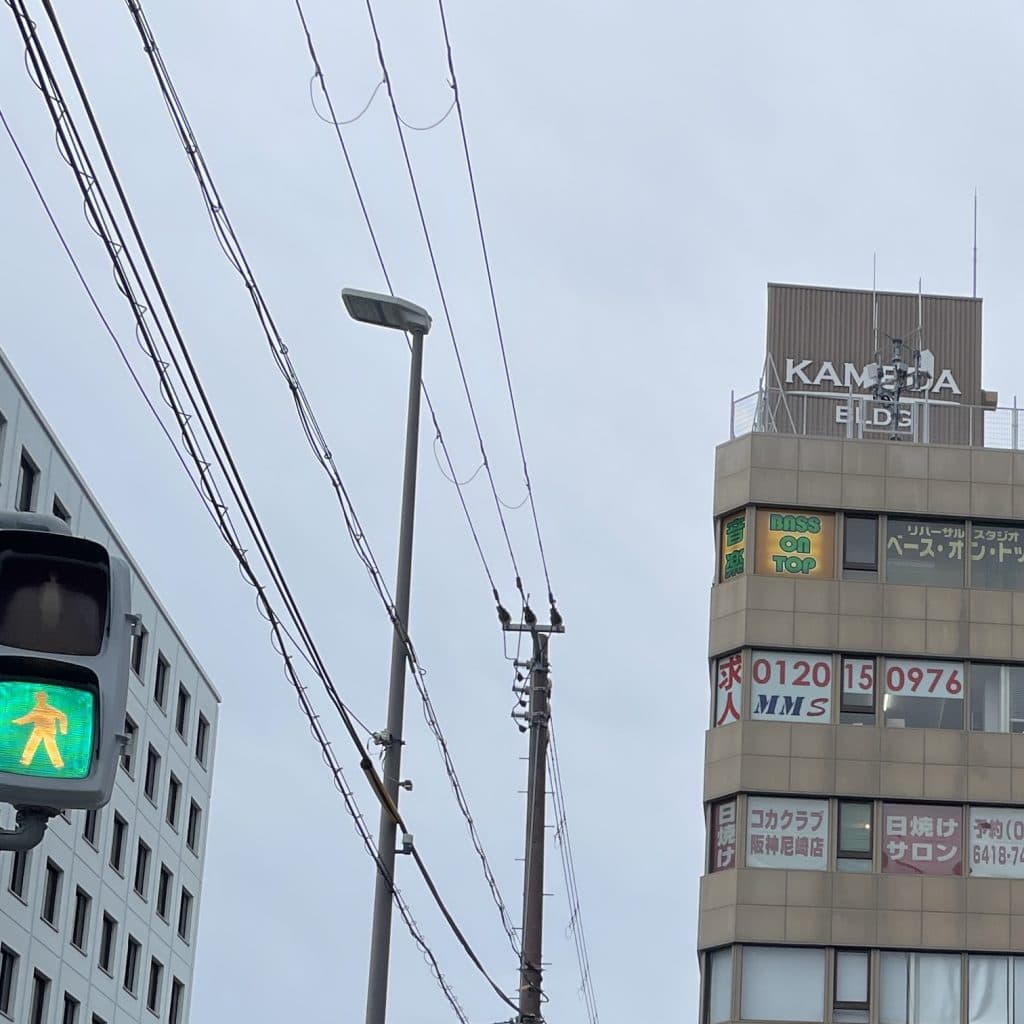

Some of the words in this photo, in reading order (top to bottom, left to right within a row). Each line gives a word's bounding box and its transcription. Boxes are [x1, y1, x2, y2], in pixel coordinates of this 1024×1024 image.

[785, 357, 961, 395] KAMEDA
[974, 529, 1020, 542] スタジオ
[772, 555, 817, 575] TOP
[752, 658, 831, 688] 0120
[845, 662, 873, 690] 15
[886, 666, 962, 695] 0976
[717, 655, 743, 726] 求人
[753, 694, 829, 717] MMS
[886, 814, 959, 838] 日焼け
[886, 841, 958, 863] サロン
